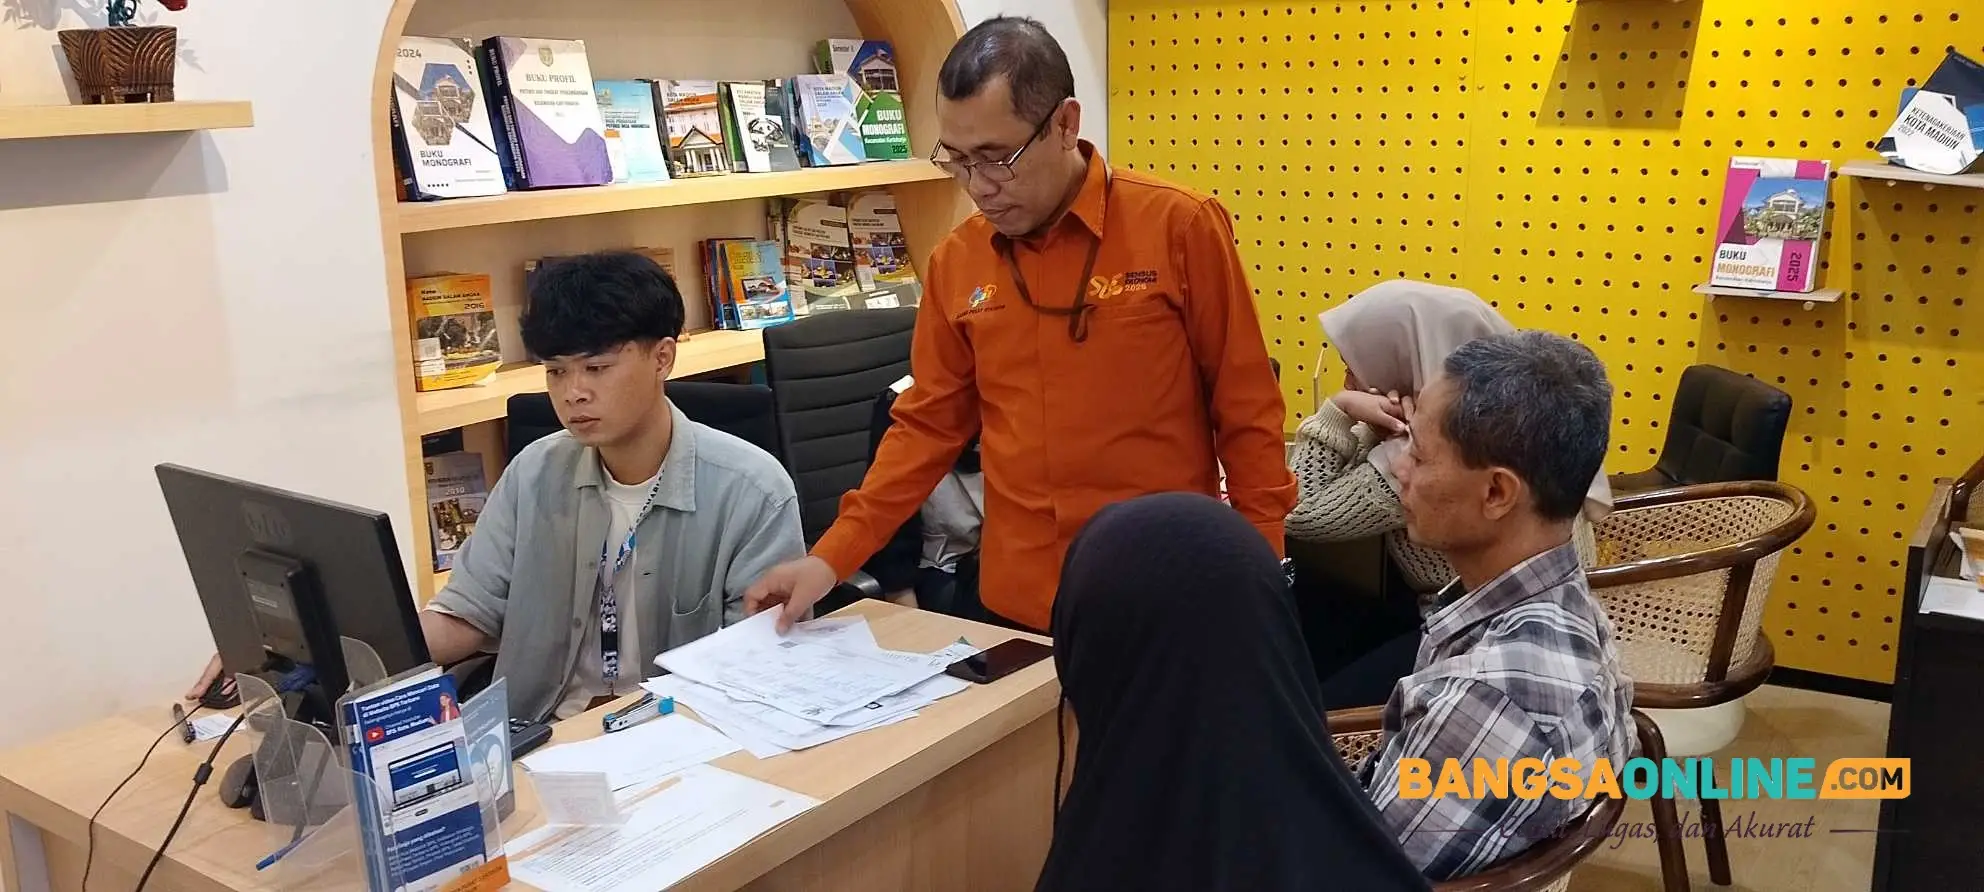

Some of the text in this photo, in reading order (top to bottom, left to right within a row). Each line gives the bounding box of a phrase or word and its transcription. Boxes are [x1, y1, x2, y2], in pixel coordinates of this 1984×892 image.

[397, 48, 422, 59] 2024
[525, 73, 577, 83] BUKU PROFIL
[876, 109, 902, 121] BUKU
[861, 123, 905, 136] MONOGRAFI
[1903, 114, 1961, 150] KOTA MADIUN
[420, 150, 444, 158] BUKU
[422, 158, 472, 168] MONOGRAFI
[1719, 249, 1747, 260] BUKU
[1716, 262, 1776, 277] MONOGRAFI
[1786, 251, 1802, 282] 2025
